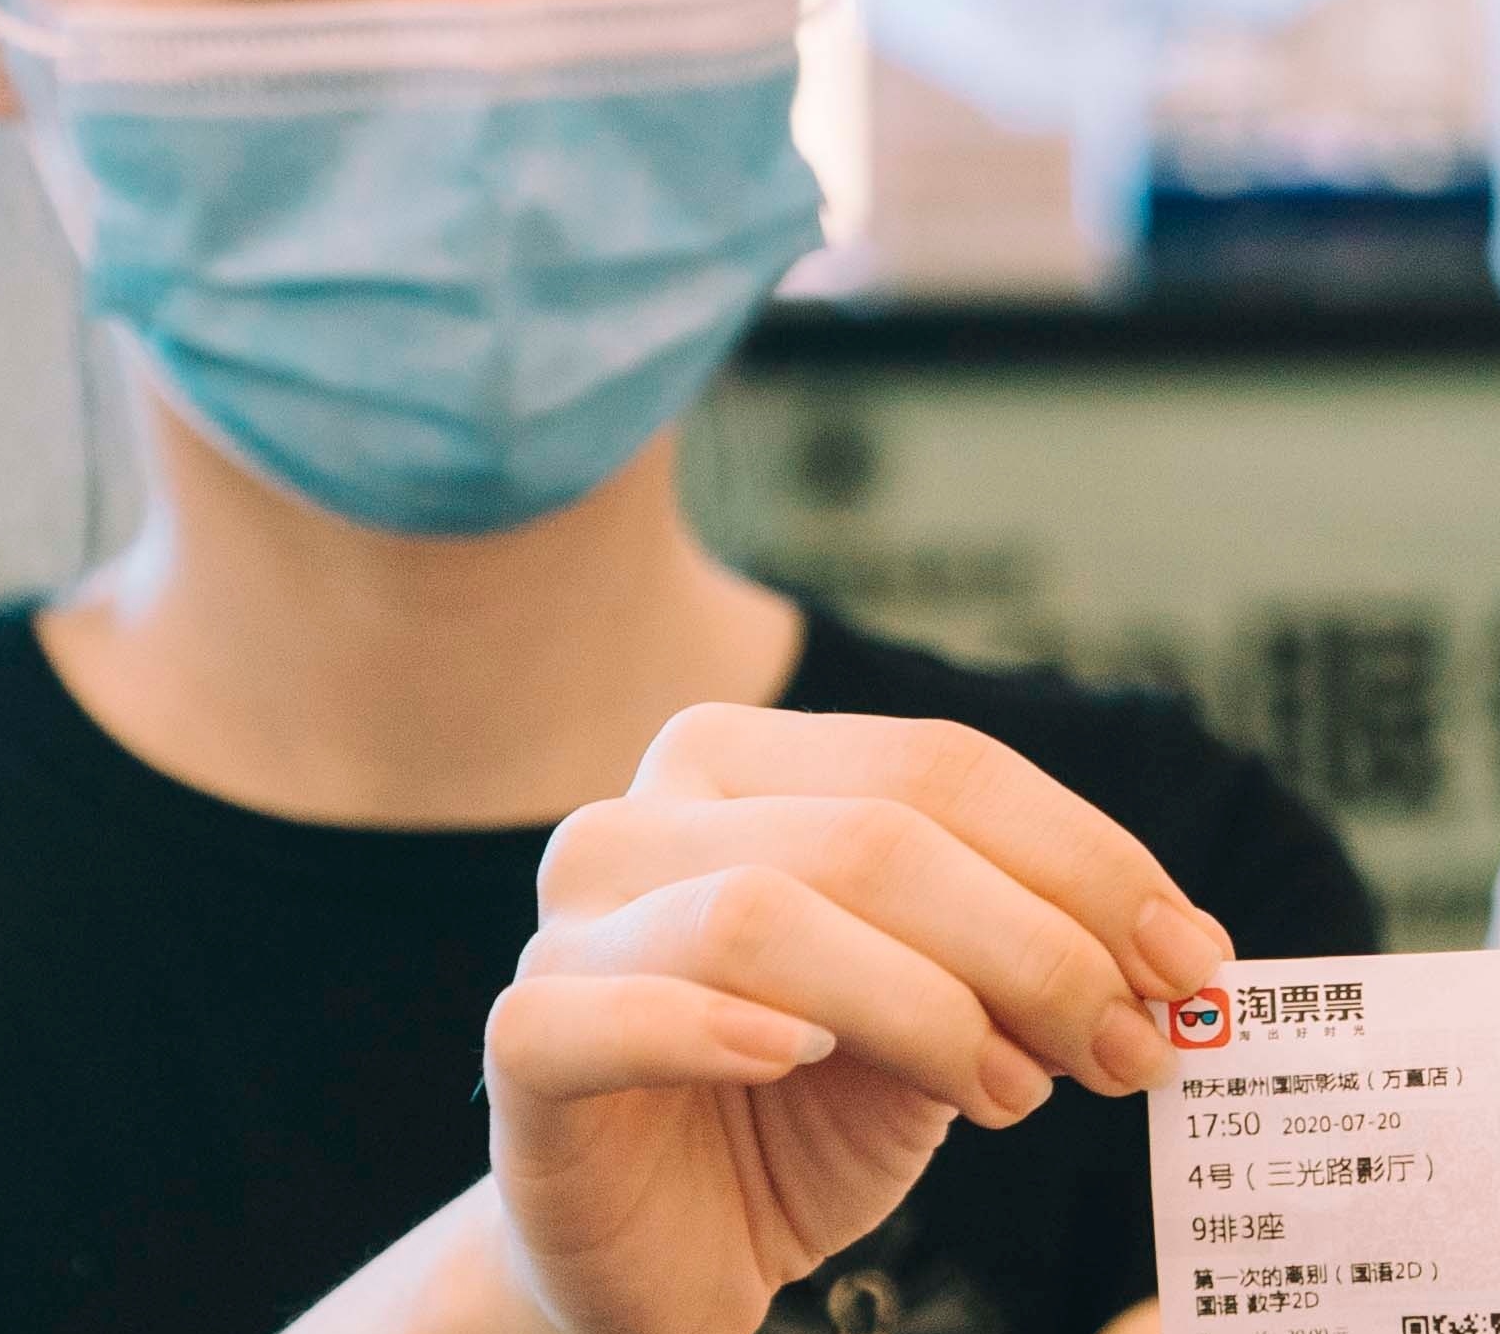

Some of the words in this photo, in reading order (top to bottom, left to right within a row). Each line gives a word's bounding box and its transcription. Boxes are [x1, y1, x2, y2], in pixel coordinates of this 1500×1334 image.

[1237, 982, 1365, 1025] 淘票票
[1187, 1111, 1262, 1139] 17:50
[1282, 1112, 1402, 1136] 2020-07-20
[1190, 1212, 1287, 1245] 9排3座
